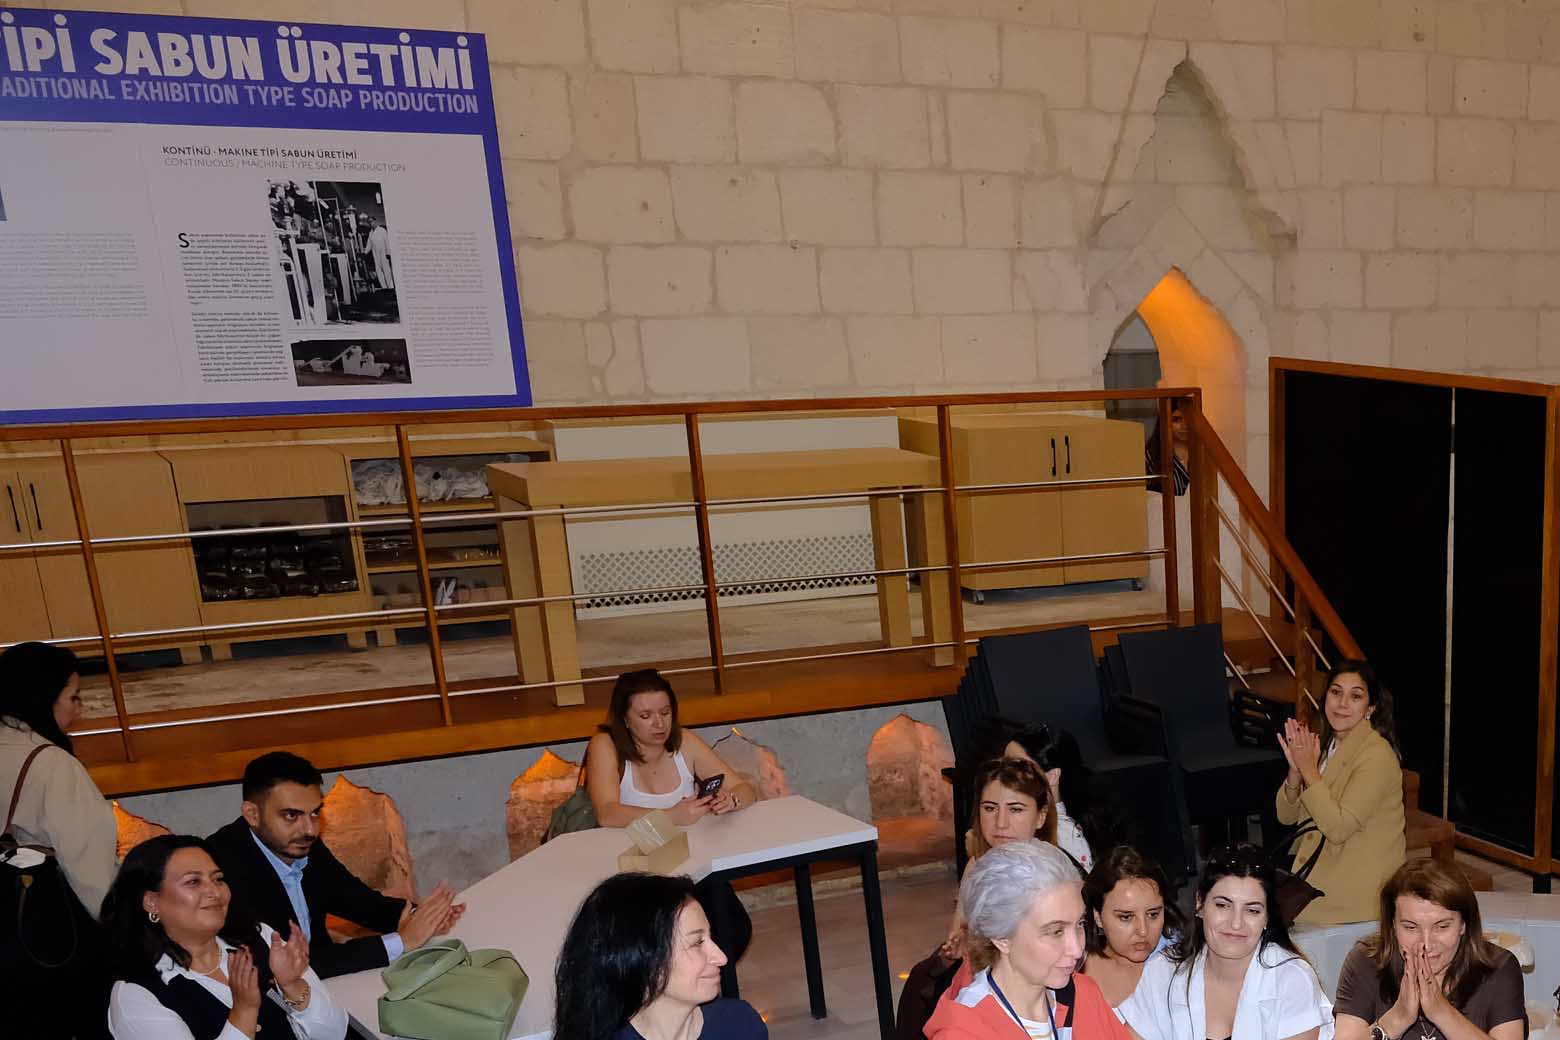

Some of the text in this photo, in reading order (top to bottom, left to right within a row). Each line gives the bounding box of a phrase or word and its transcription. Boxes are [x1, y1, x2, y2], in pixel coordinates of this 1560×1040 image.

[0, 11, 475, 90] İPİ SABUN ÜRETİMİ
[121, 80, 239, 105] EXHIBITION
[243, 85, 296, 107] TYPE
[301, 87, 352, 109] SOAP
[359, 90, 480, 114] PRODUCTION
[281, 149, 315, 158] SABUN
